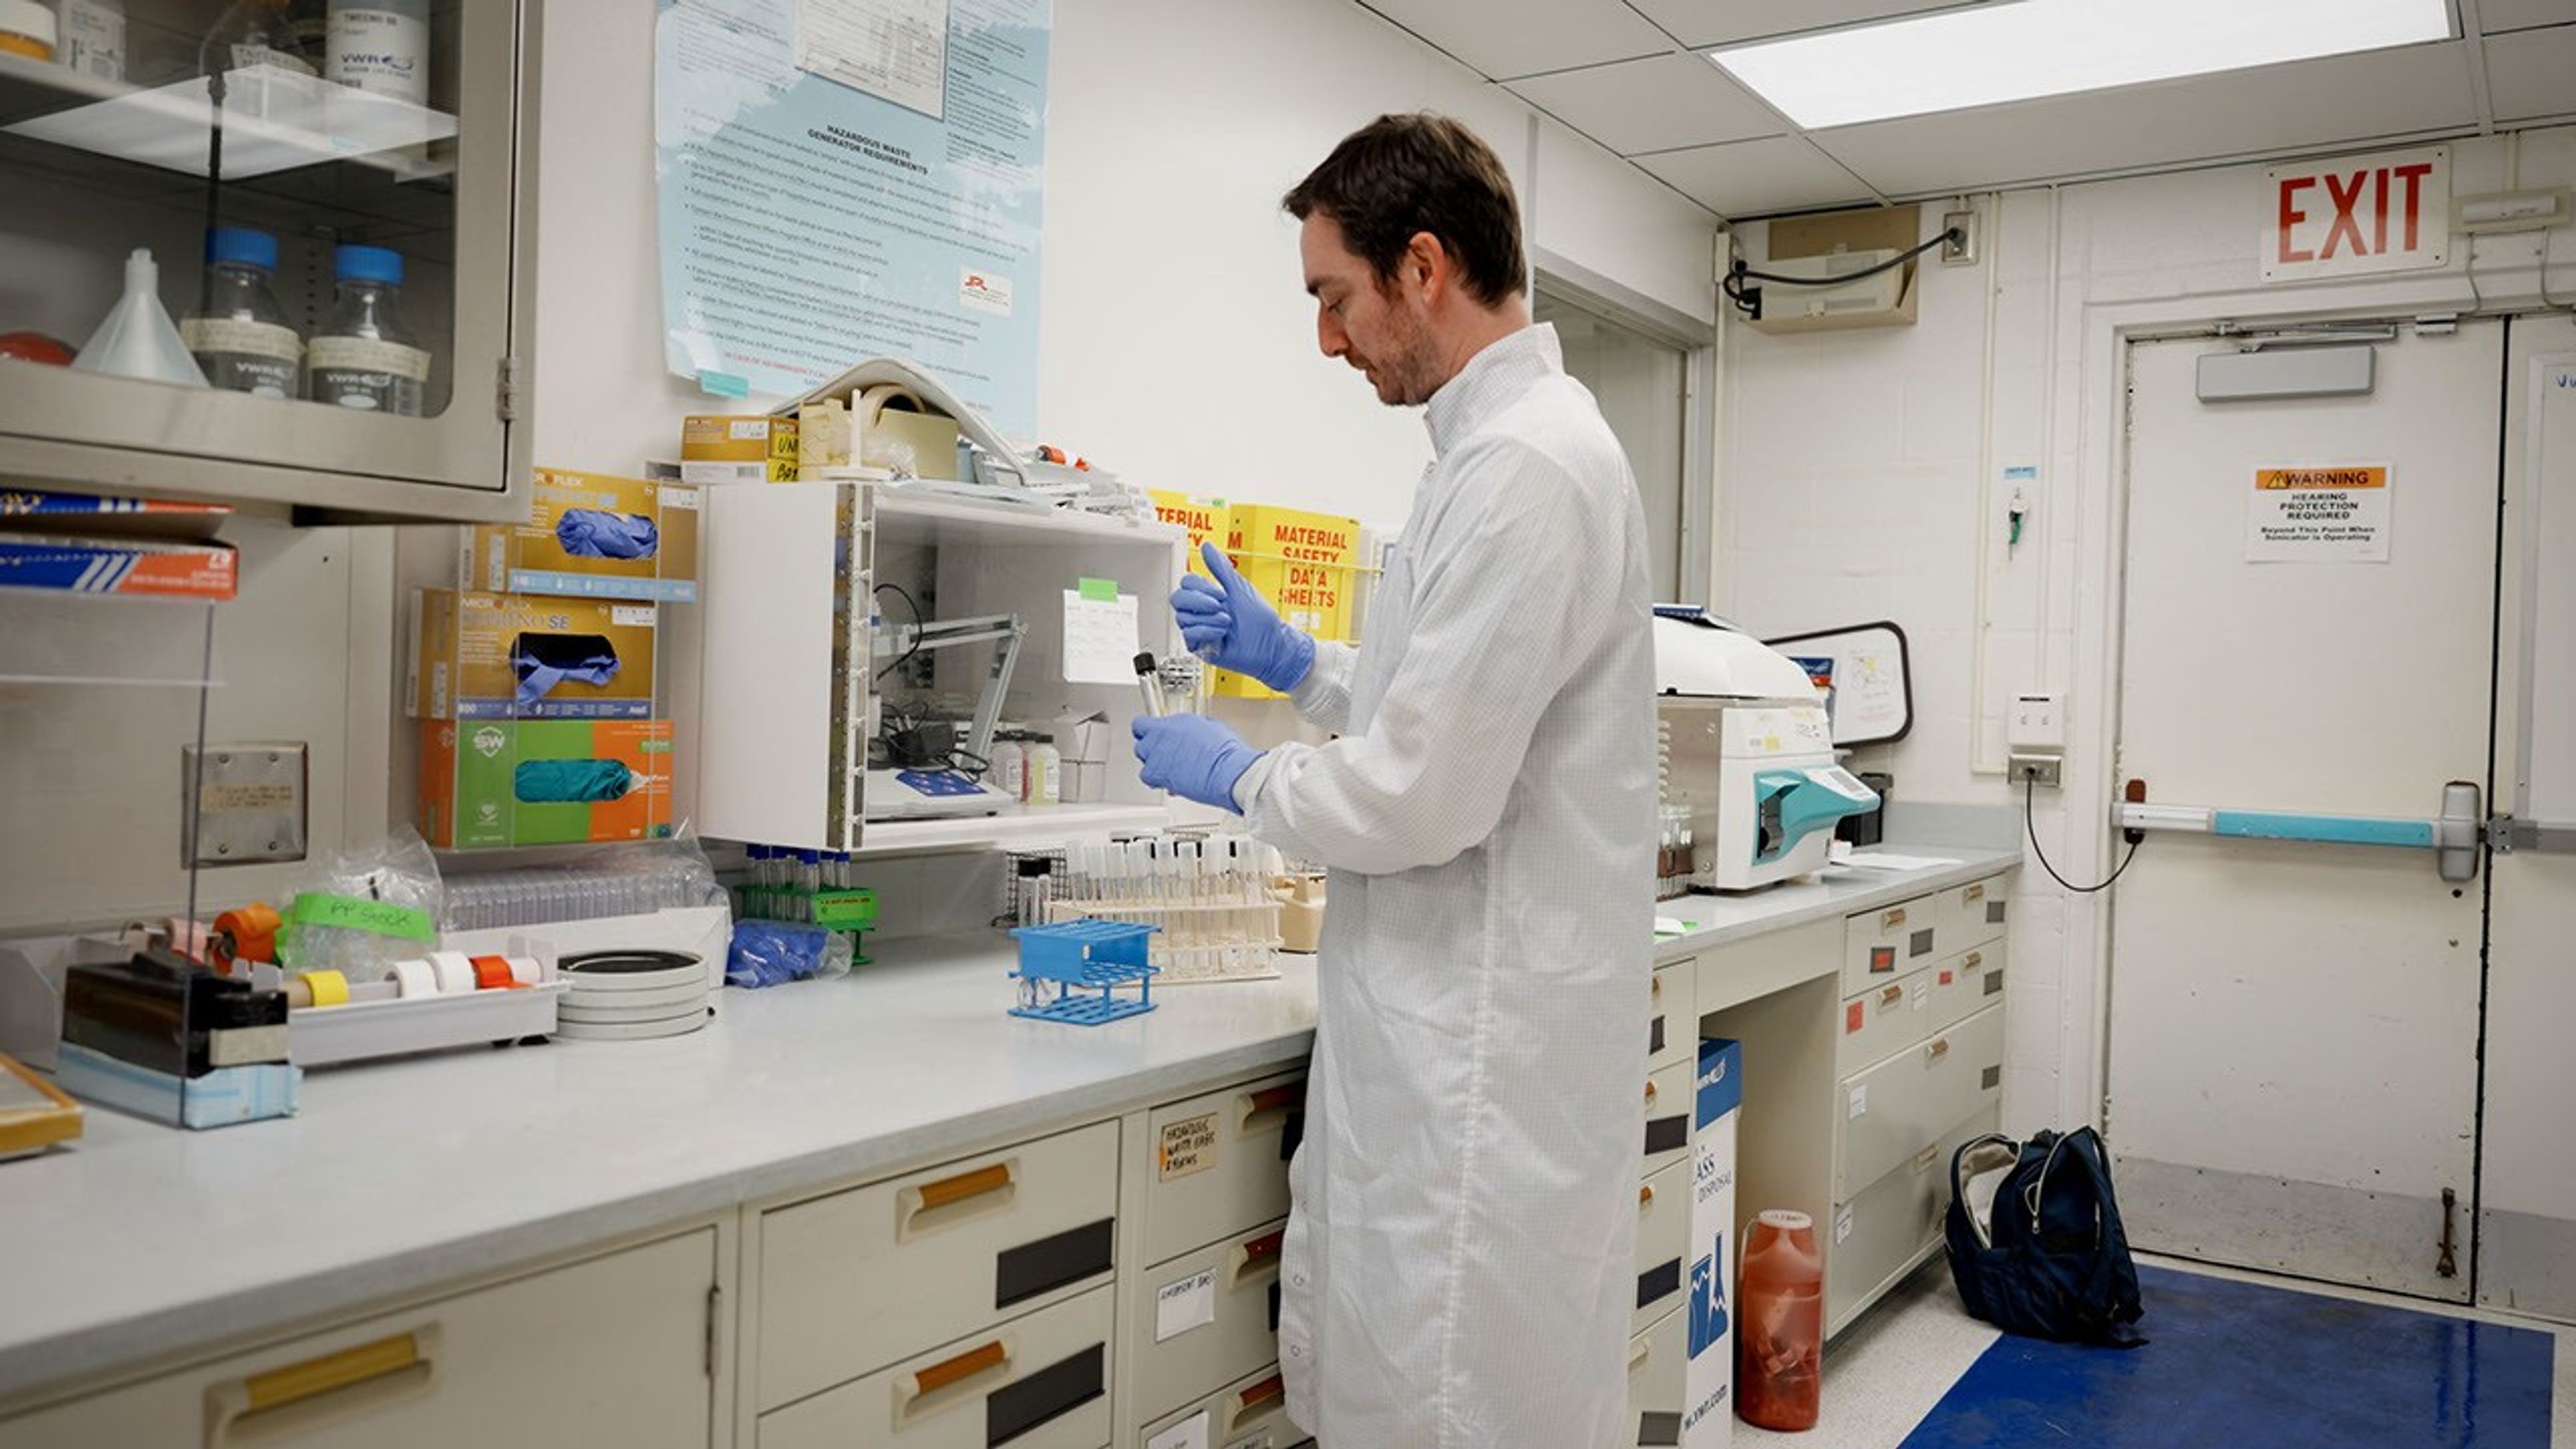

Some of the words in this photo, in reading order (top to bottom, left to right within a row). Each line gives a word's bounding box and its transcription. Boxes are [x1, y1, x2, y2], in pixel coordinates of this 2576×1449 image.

[827, 125, 880, 149] HAZARDOUS
[883, 144, 911, 160] WASTE
[807, 129, 861, 152] GENERATOR
[863, 148, 928, 175] REQUIREMENTS
[2278, 163, 2432, 264] EXIT
[2286, 472, 2369, 484] WARNING
[2292, 493, 2348, 501] HEARING
[1155, 506, 1213, 531] TERIAL
[2287, 511, 2350, 520] REQUIRED
[1275, 525, 1348, 550] MATERIAL
[2261, 527, 2296, 535] Beyond
[2323, 534, 2371, 543] Operating
[1283, 547, 1340, 565] SAFETY
